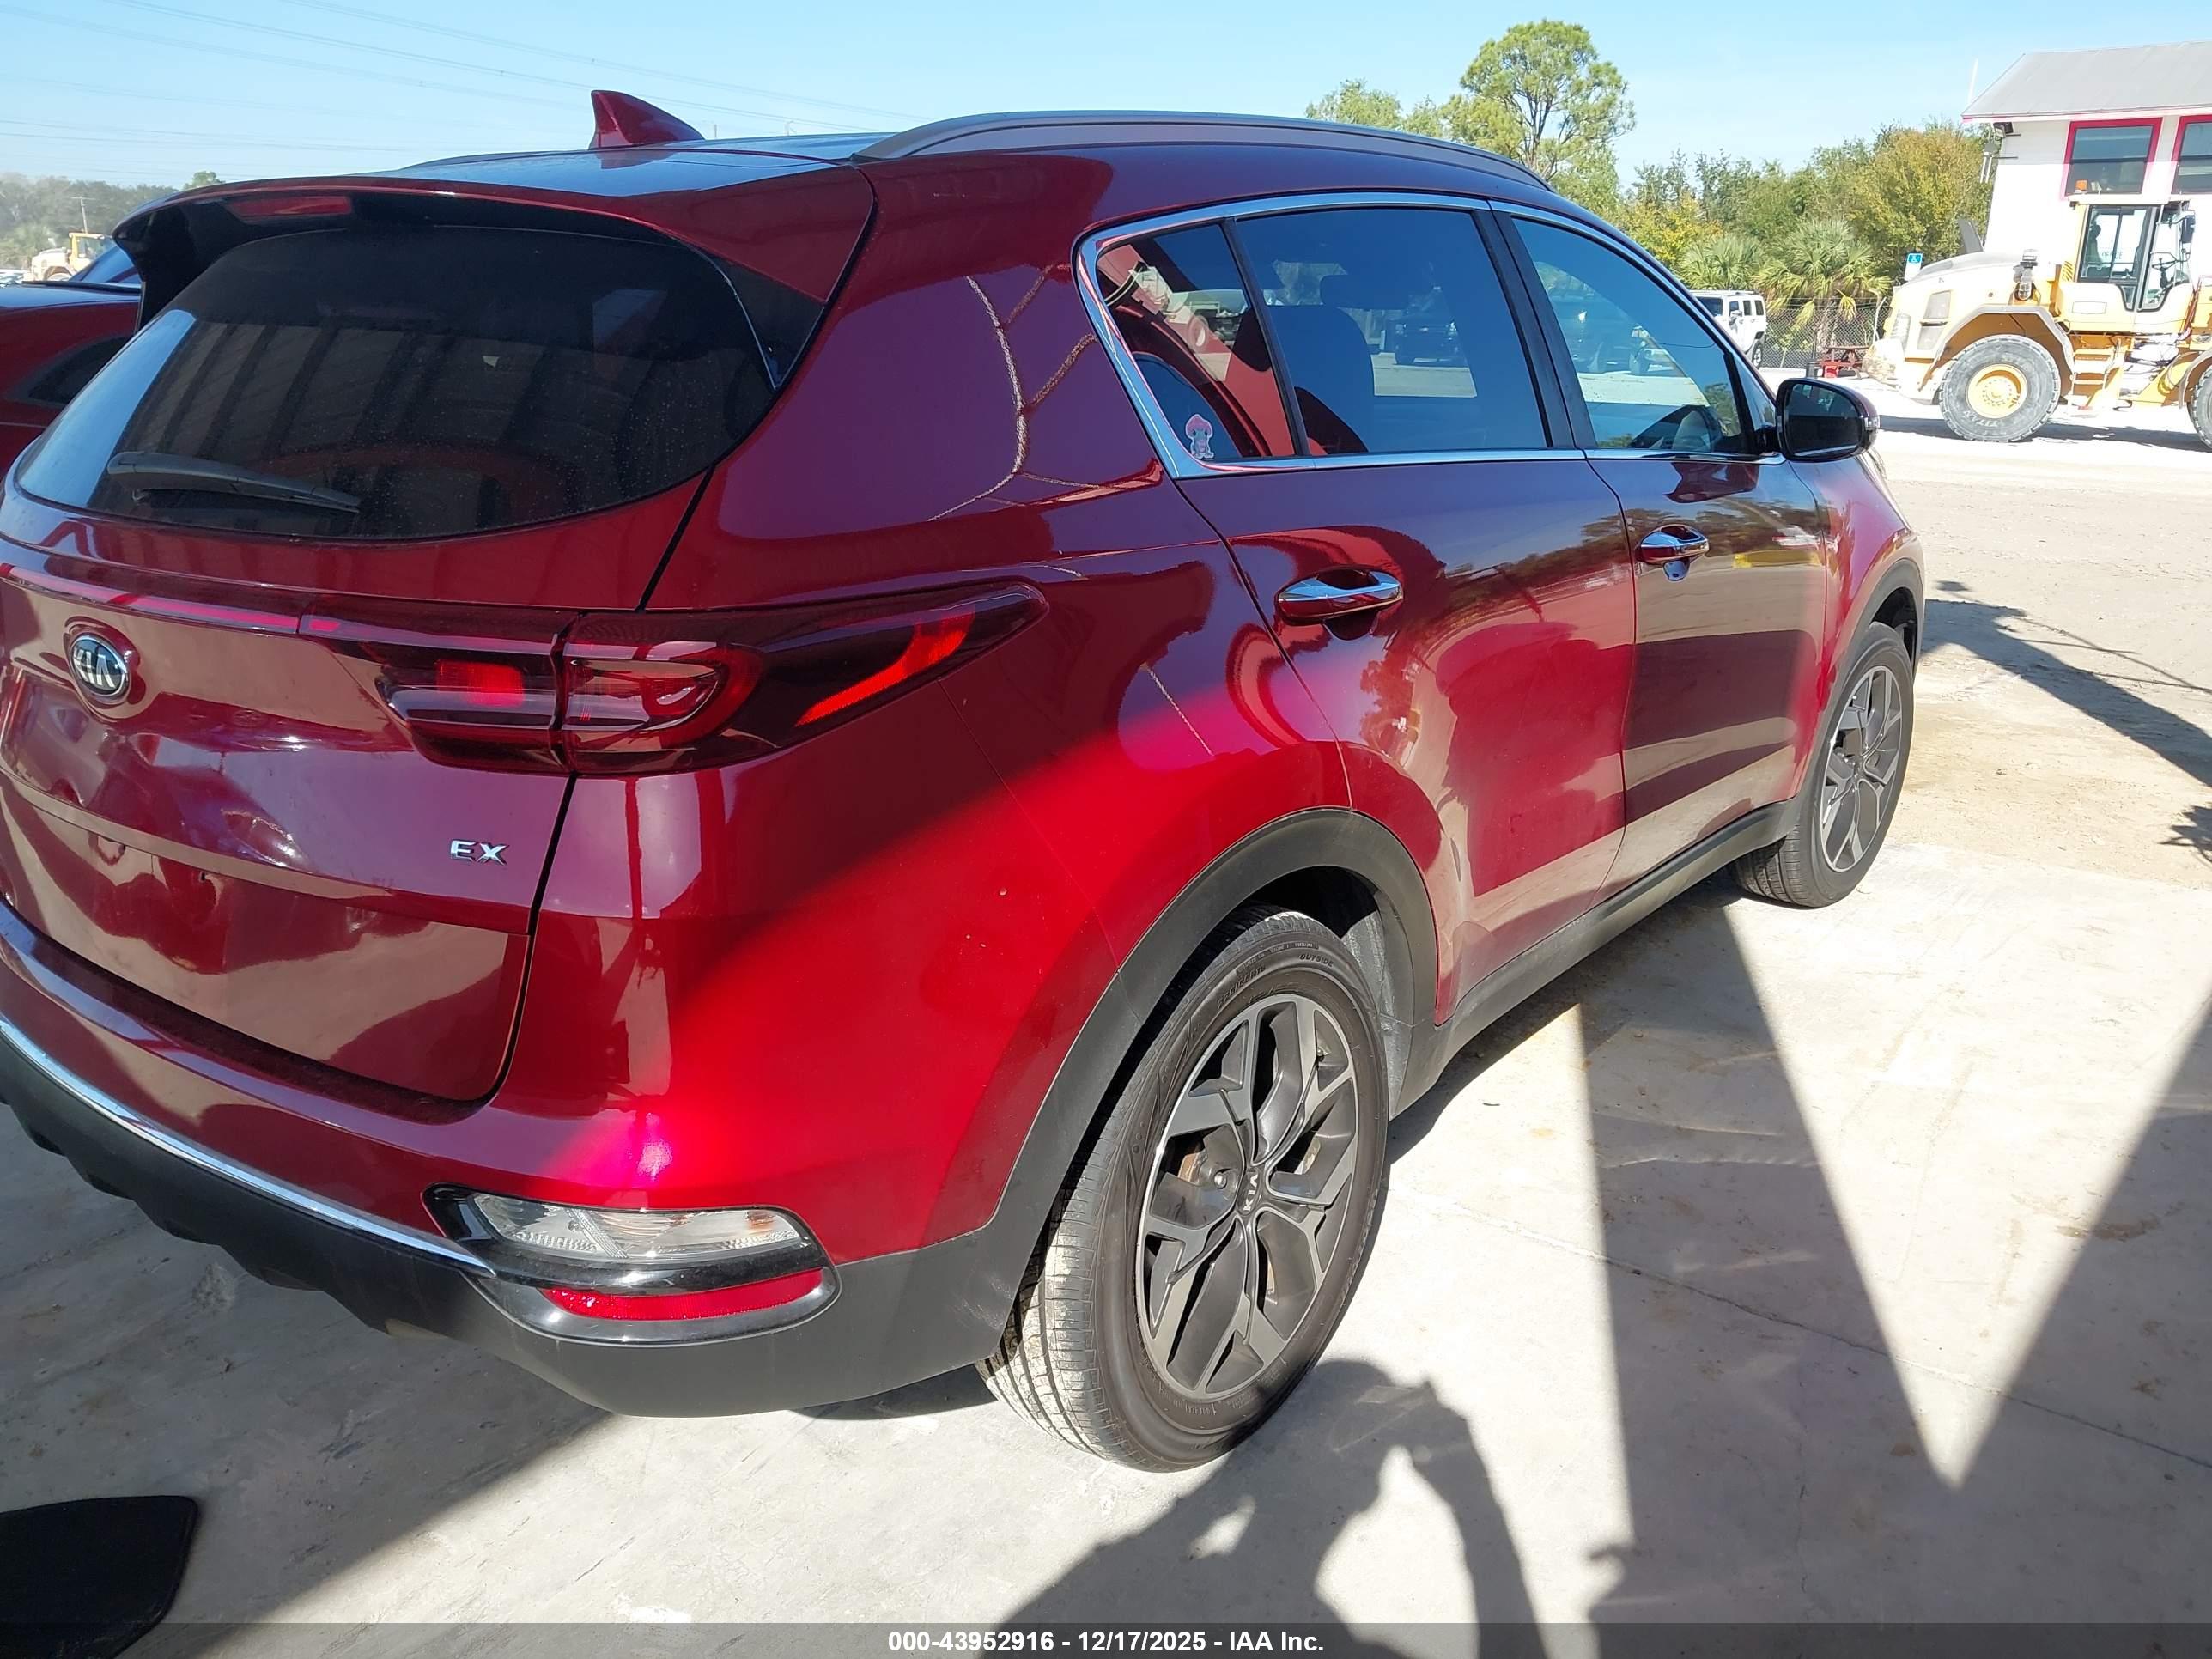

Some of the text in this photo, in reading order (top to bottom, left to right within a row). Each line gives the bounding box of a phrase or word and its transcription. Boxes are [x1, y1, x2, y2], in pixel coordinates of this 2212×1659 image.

[2101, 250, 2124, 259] OFFCE
[73, 647, 116, 689] KIA
[450, 838, 509, 866] EX
[1298, 953, 1334, 968] OUTSIDE
[1243, 1174, 1259, 1211] KIA
